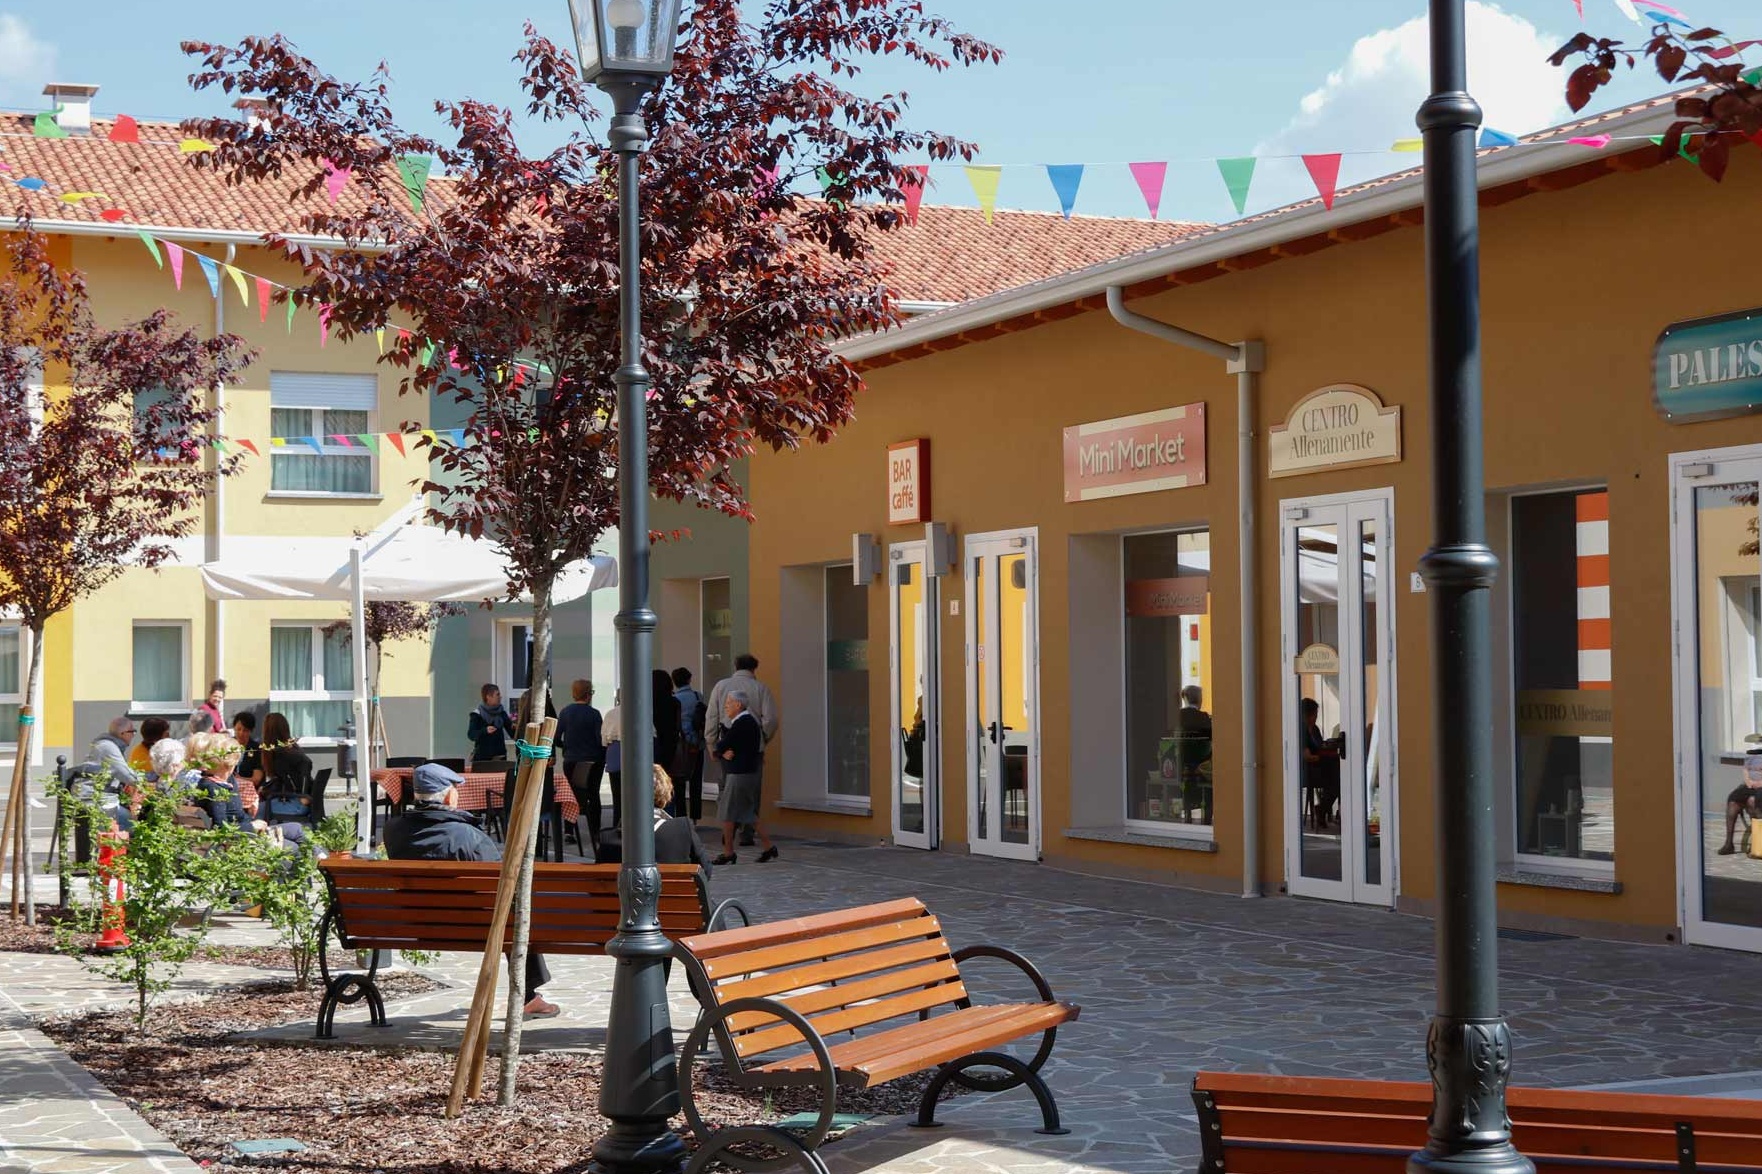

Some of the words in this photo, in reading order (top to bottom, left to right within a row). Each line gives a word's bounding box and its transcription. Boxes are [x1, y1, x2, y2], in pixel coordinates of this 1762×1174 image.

[1668, 339, 1762, 389] PALES
[1302, 403, 1359, 433] CENTRO
[1080, 442, 1115, 477] Mini
[1118, 431, 1185, 471] Market
[1290, 428, 1375, 460] Allenamente
[893, 459, 912, 482] BAR
[892, 484, 914, 509] caffé
